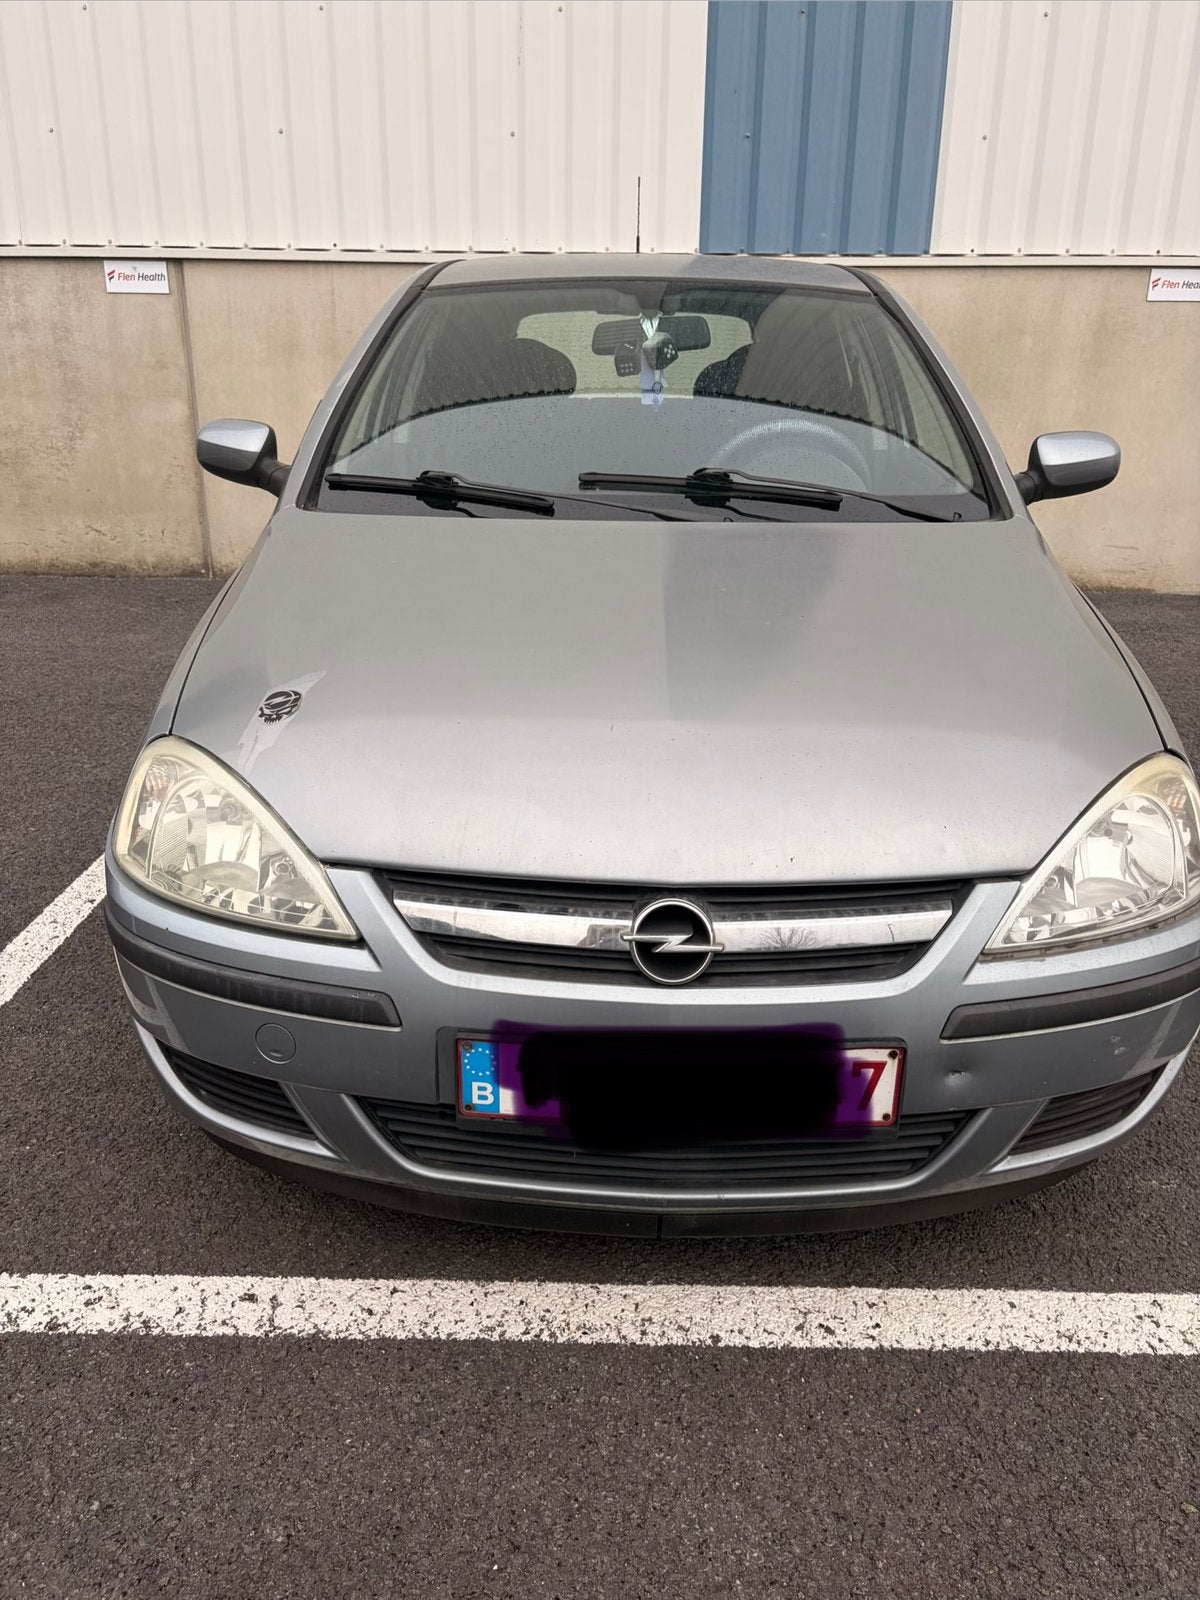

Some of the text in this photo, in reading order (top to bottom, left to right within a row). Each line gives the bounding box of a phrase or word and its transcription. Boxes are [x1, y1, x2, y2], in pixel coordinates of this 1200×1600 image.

[118, 272, 166, 282] Flen Health
[1161, 280, 1200, 289] Flen Hea
[471, 1081, 495, 1105] B
